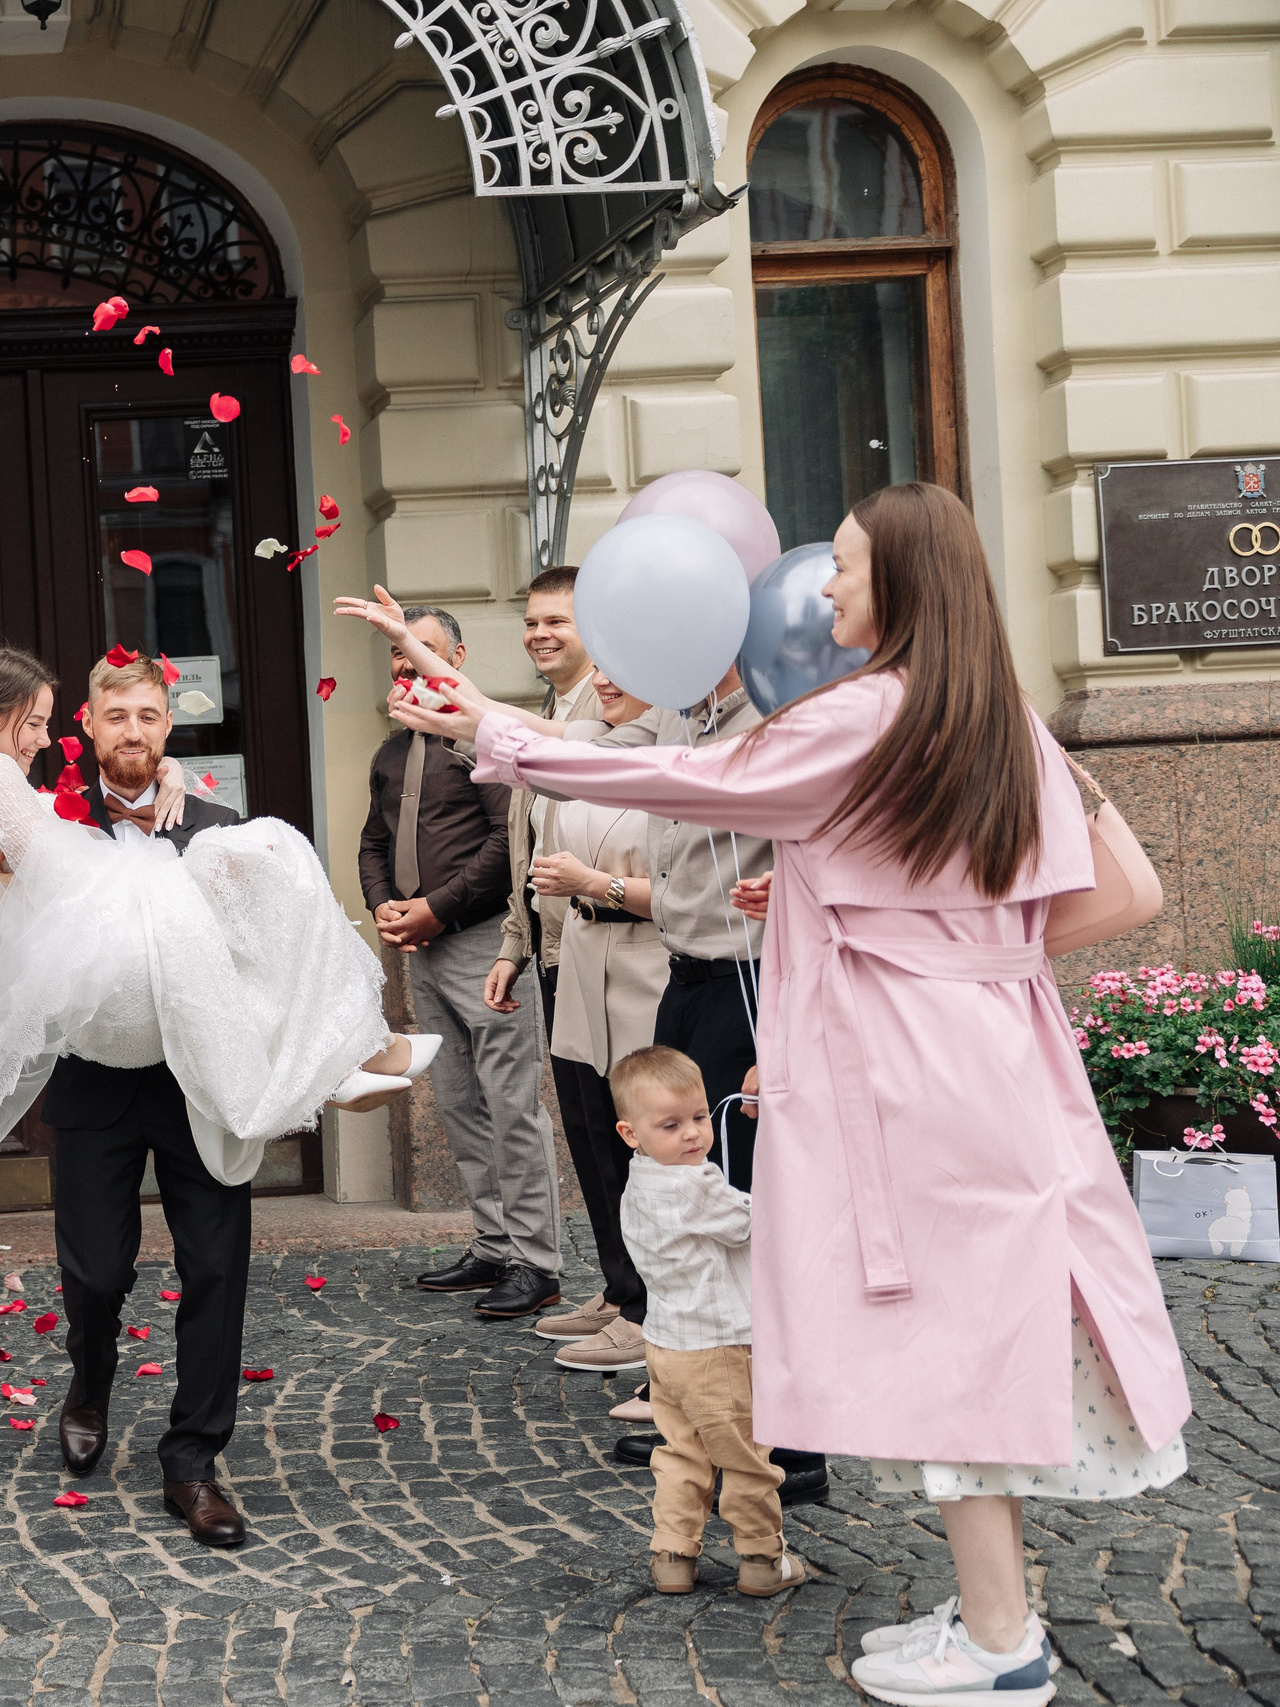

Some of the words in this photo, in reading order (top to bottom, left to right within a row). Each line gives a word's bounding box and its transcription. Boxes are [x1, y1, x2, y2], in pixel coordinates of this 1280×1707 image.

[190, 454, 224, 462] ALPHA
[190, 460, 224, 468] SECTOR
[1187, 502, 1243, 510] ПРАВИТЕЛЬСТВО
[1138, 512, 1170, 520] КОМИТЕТ
[1186, 511, 1211, 519] ДЕЛАМ
[1215, 509, 1241, 517] ЗАПИСИ
[1245, 507, 1267, 515] АКТОВ
[1202, 564, 1280, 592] ДВОР
[1131, 597, 1280, 626] БРАКОСОЧ
